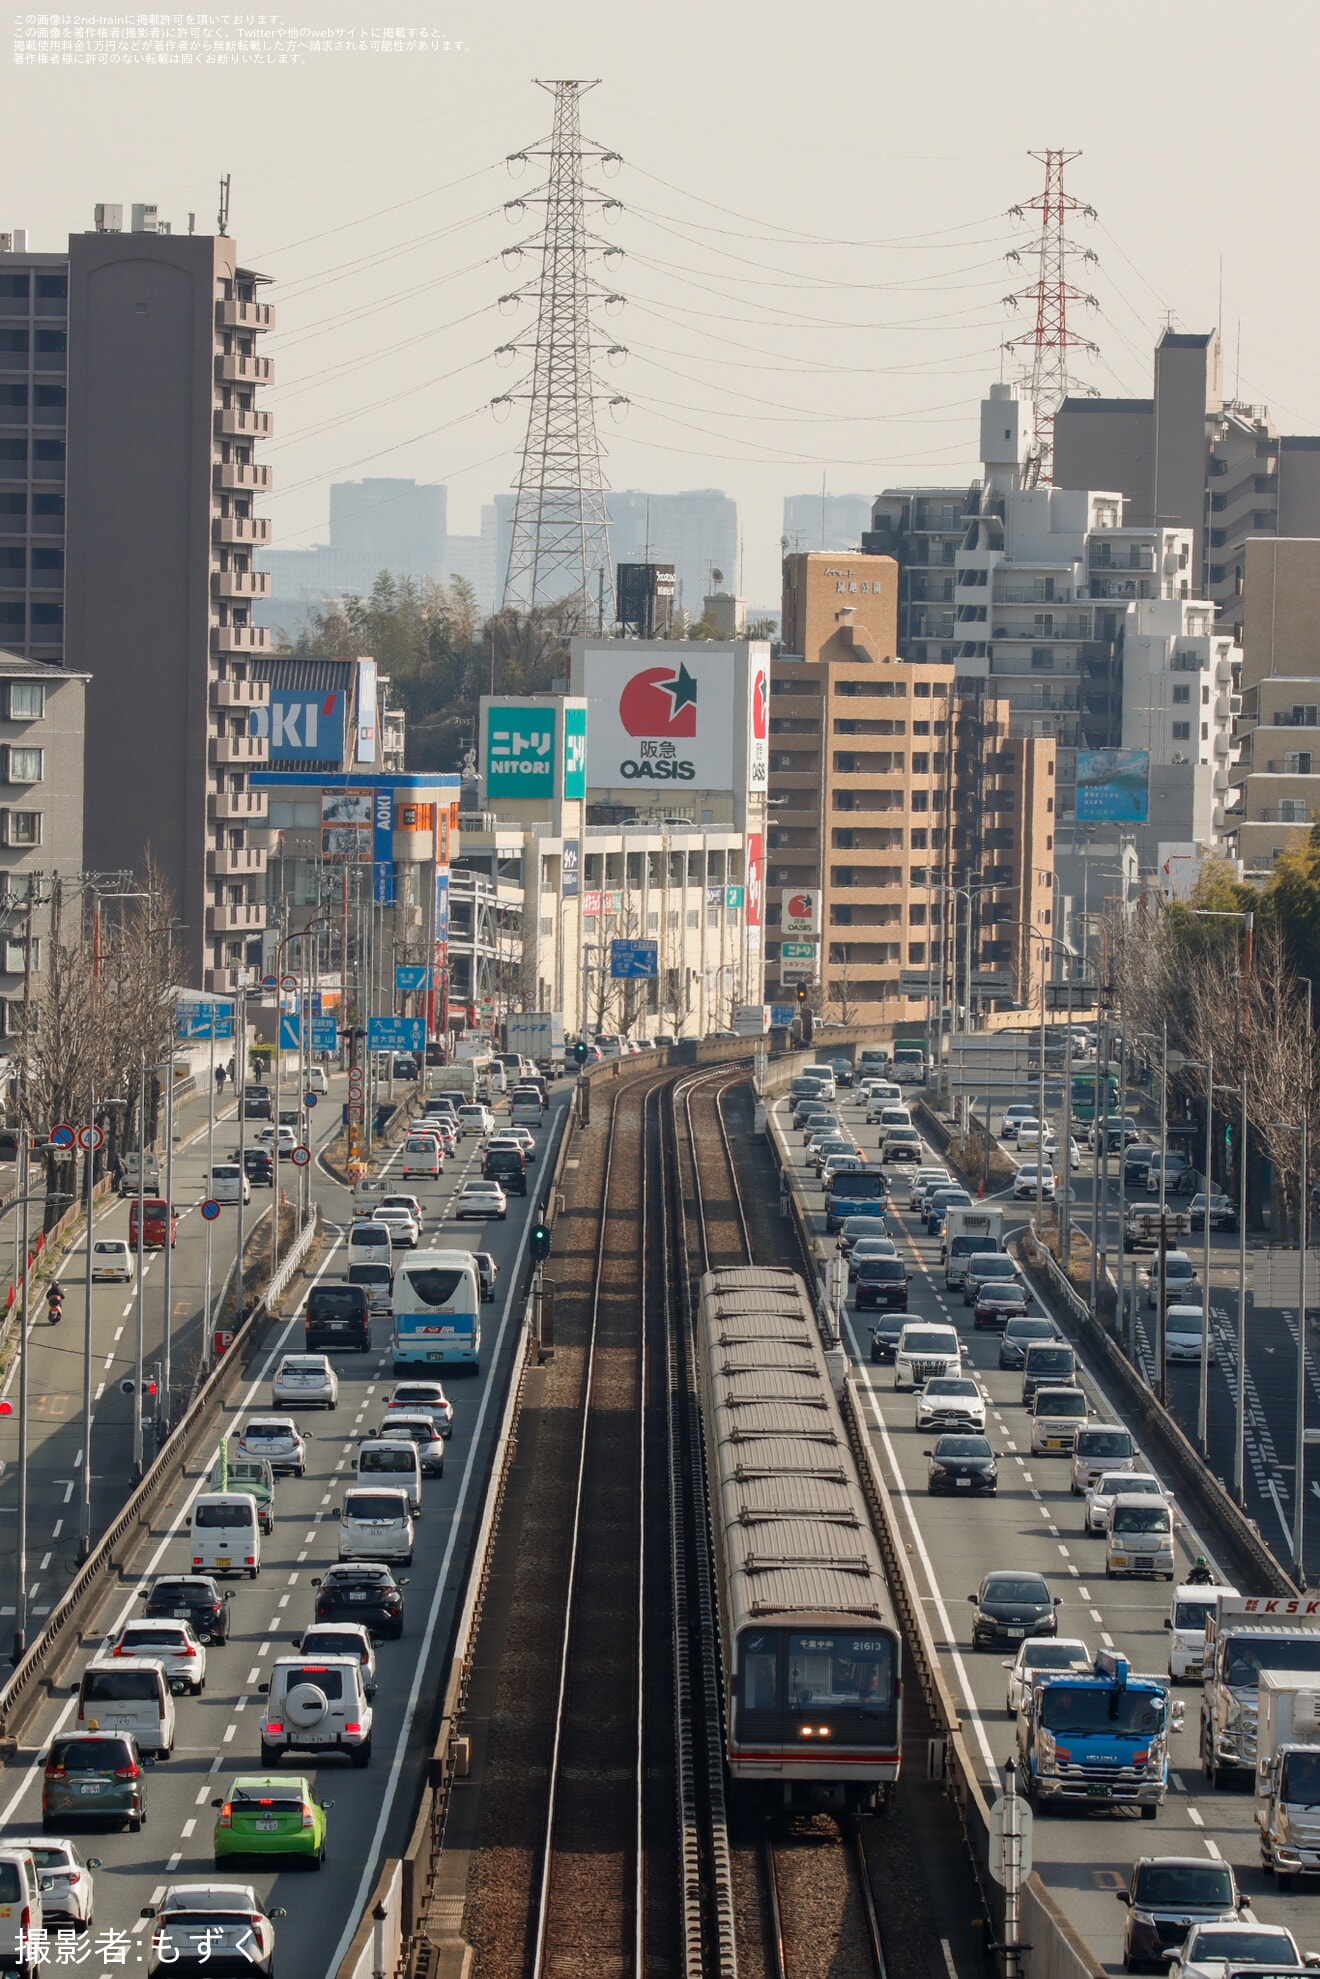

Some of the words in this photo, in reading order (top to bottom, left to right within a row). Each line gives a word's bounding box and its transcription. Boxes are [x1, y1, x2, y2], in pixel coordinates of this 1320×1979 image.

[491, 732, 551, 756] ニトリ
[640, 741, 677, 759] 阪急
[567, 735, 585, 772] ニトリ
[491, 761, 550, 774] NITORI
[620, 760, 695, 780] OASIS
[377, 795, 392, 831] AOKI
[788, 946, 811, 956] ニトリ
[295, 1151, 307, 1161] 60
[853, 1641, 881, 1651] 21613
